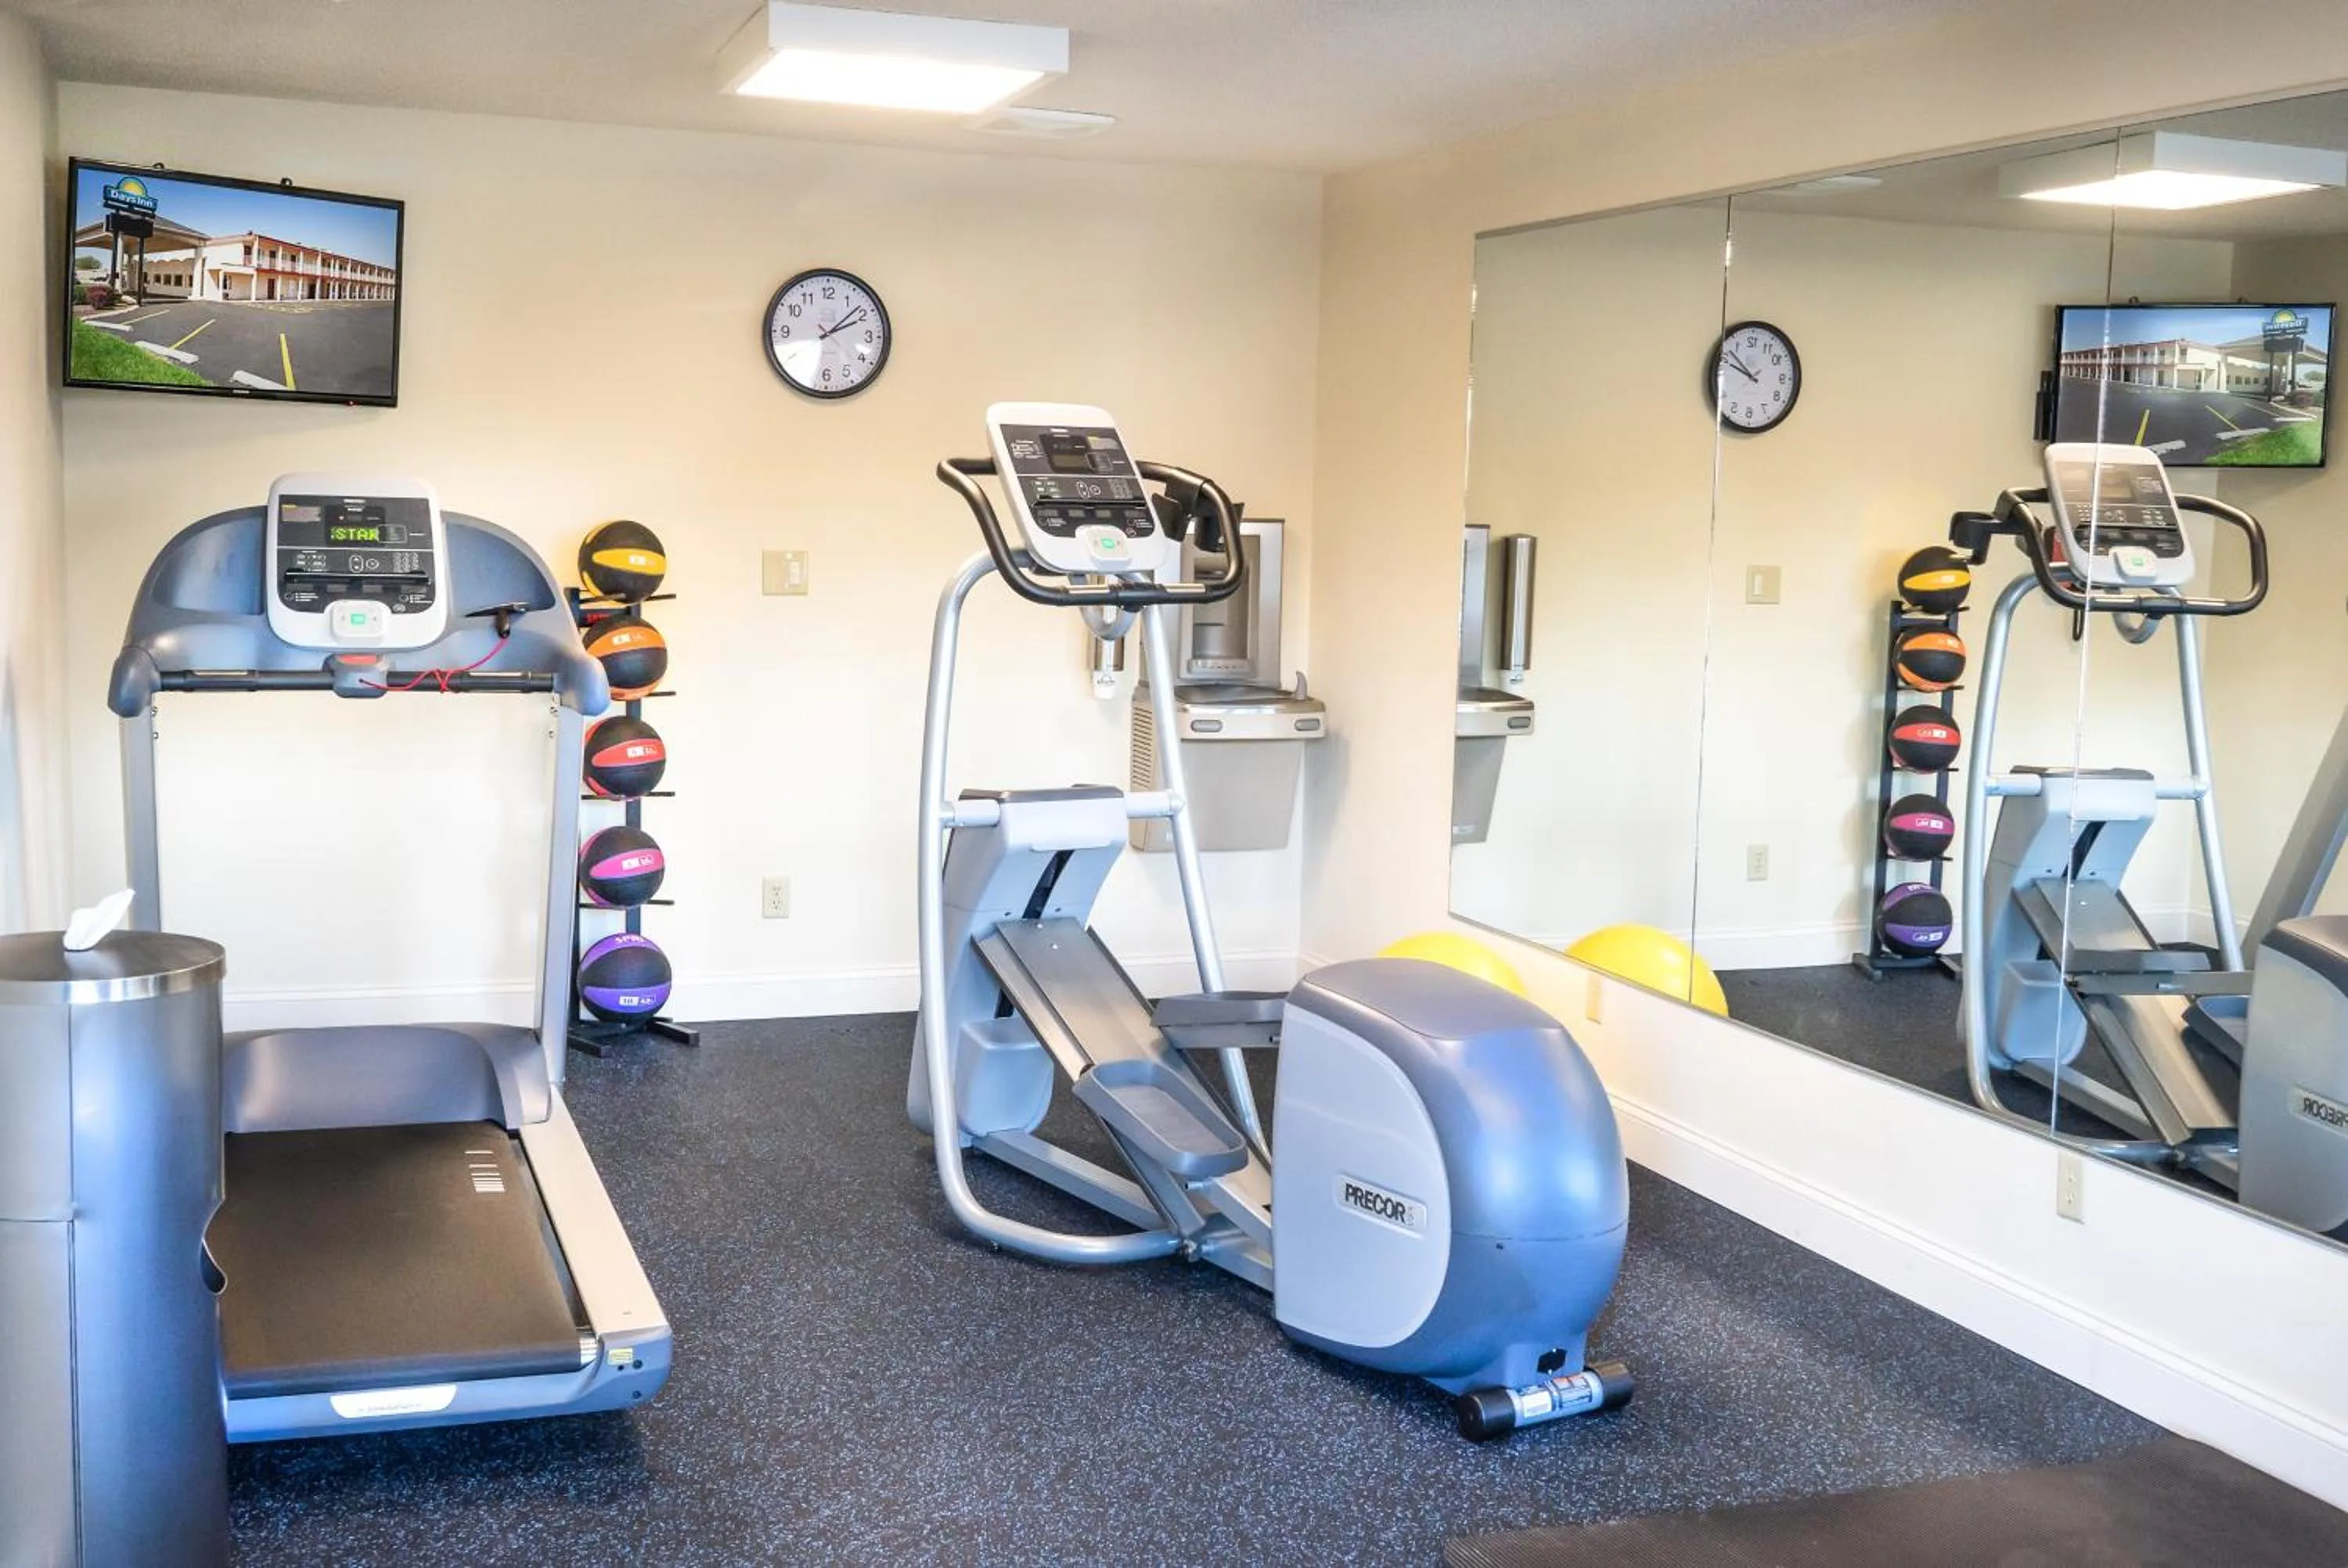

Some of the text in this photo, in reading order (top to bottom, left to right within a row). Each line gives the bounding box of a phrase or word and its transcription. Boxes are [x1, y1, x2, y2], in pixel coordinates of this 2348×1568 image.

[801, 293, 813, 305] 11
[822, 286, 835, 300] 12
[844, 295, 850, 307] 1
[788, 304, 801, 318] 10
[858, 309, 867, 322] 2
[780, 325, 790, 338] 9
[864, 329, 873, 343] 3
[857, 352, 866, 363] 4
[822, 369, 831, 381] 6
[841, 364, 851, 377] 5
[1345, 1182, 1406, 1223] PRECOR
